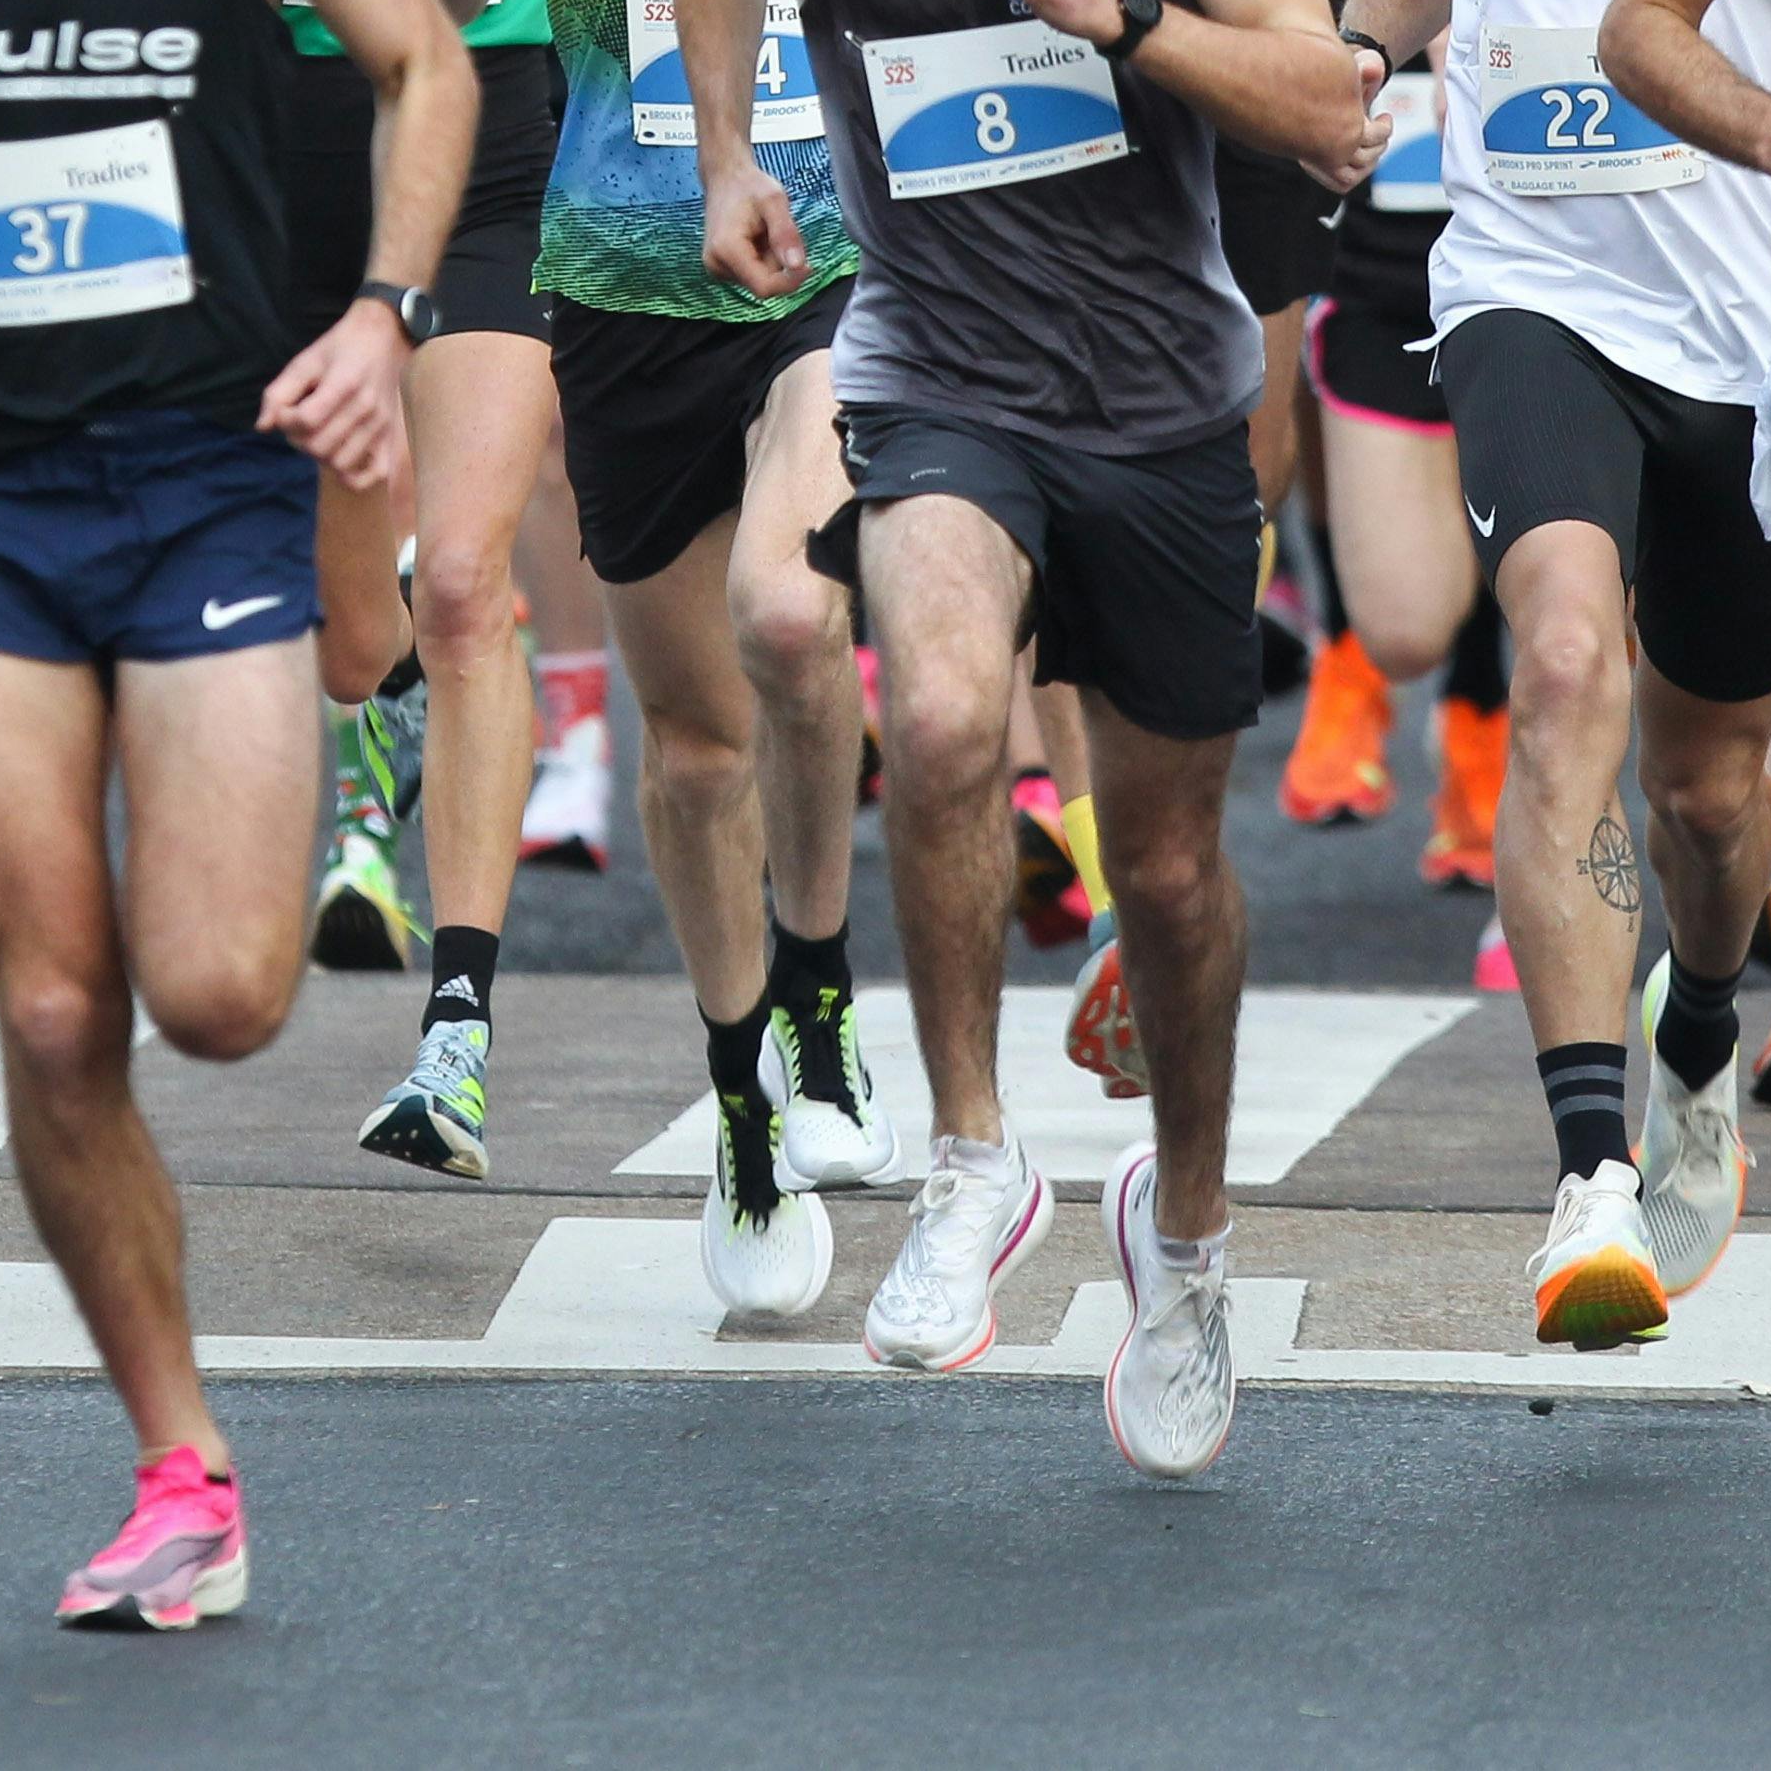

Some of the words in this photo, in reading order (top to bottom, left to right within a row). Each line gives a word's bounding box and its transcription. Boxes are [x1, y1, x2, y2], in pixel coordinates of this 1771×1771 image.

[644, 4, 676, 22] S2S
[1000, 44, 1086, 75] Tradies
[1488, 49, 1512, 69] S2S
[883, 65, 915, 86] S2S
[649, 110, 682, 121] BROOKS
[763, 105, 806, 117] BROOKS
[1540, 86, 1617, 149] 22
[972, 90, 1017, 155] 8
[1497, 159, 1526, 171] BROOKS
[1526, 160, 1543, 171] PRO
[1543, 160, 1575, 171] SPRINT
[1597, 156, 1643, 169] BROOKS
[63, 159, 149, 190] Tradies
[1510, 180, 1555, 191] BAGGAGE
[1556, 180, 1578, 191] TAG
[6, 202, 88, 275] 37
